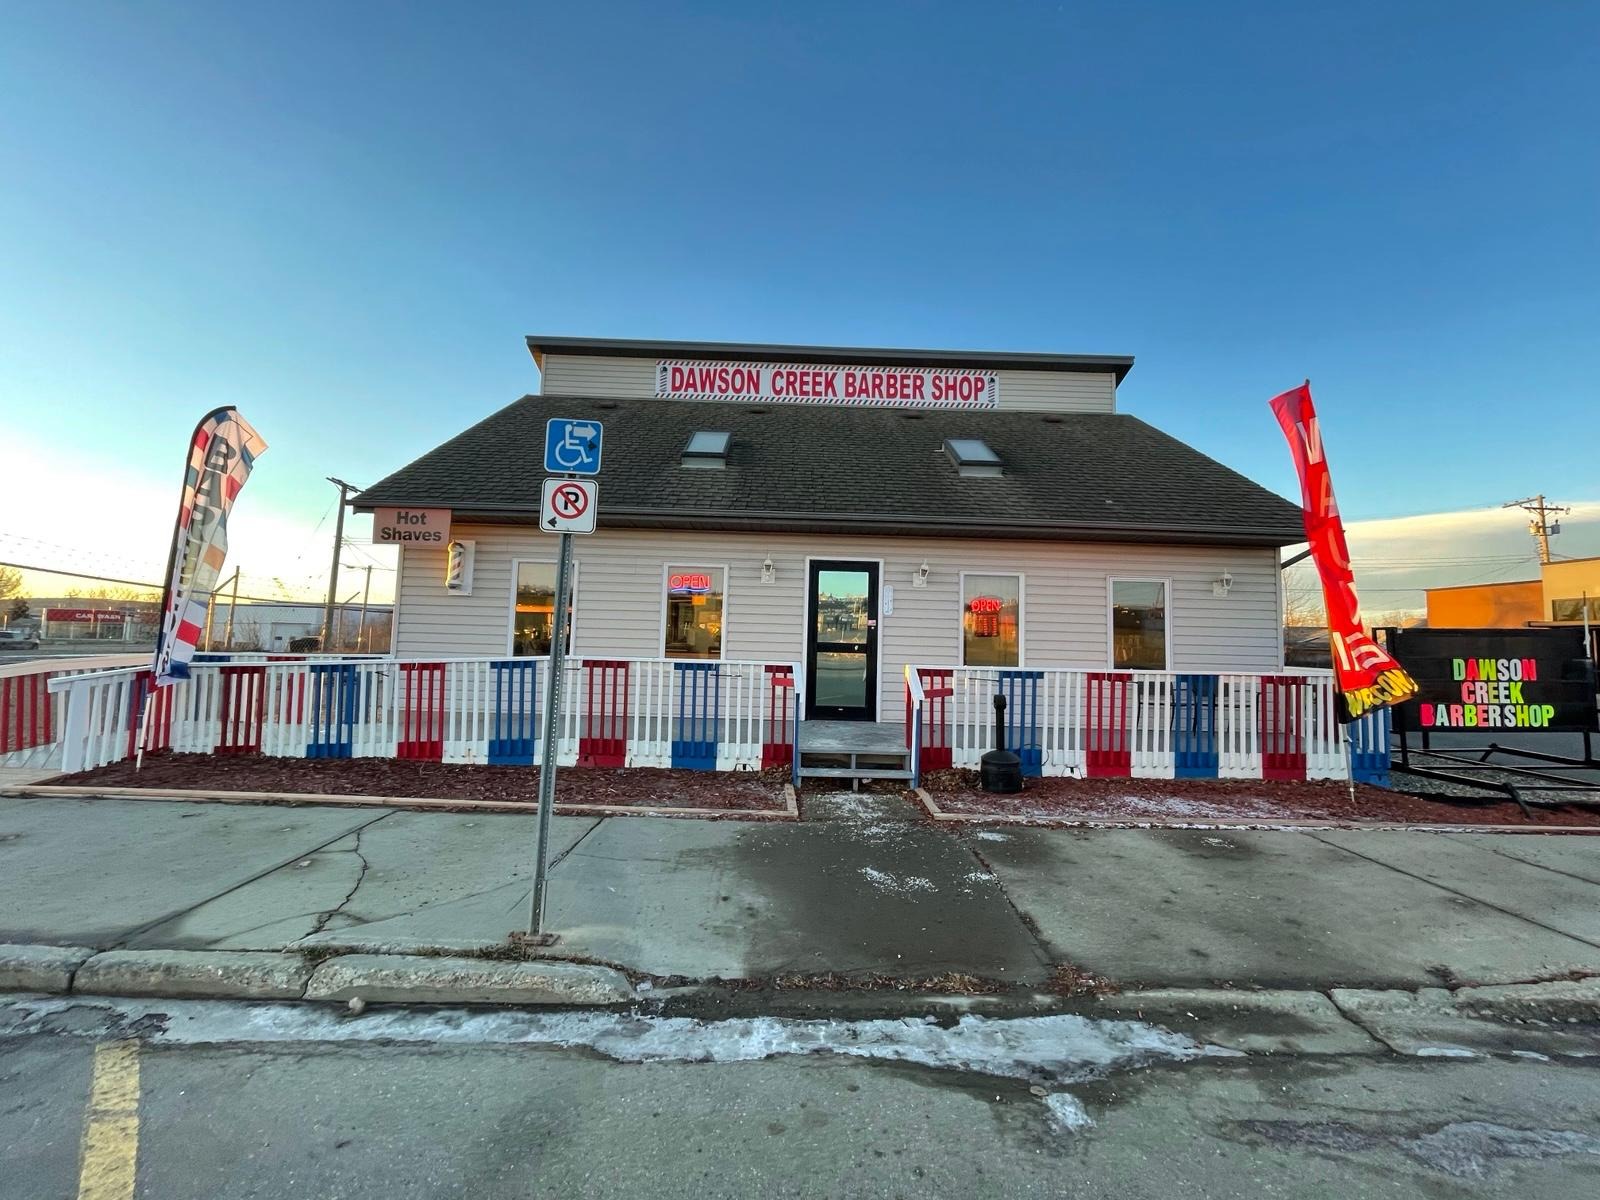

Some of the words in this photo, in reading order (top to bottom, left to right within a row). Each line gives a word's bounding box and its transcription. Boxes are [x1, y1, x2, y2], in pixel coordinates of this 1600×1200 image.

[671, 367, 760, 395] DAWSON
[771, 370, 837, 397] CREEK
[844, 374, 924, 400] BARBER
[931, 375, 985, 401] SHOP
[563, 491, 580, 510] P
[397, 511, 427, 525] Hot
[381, 527, 442, 541] Shaves
[670, 575, 710, 589] OPEN
[971, 599, 1000, 611] OPEN
[1453, 658, 1537, 681] DAWSON
[1461, 681, 1525, 704] CREEK
